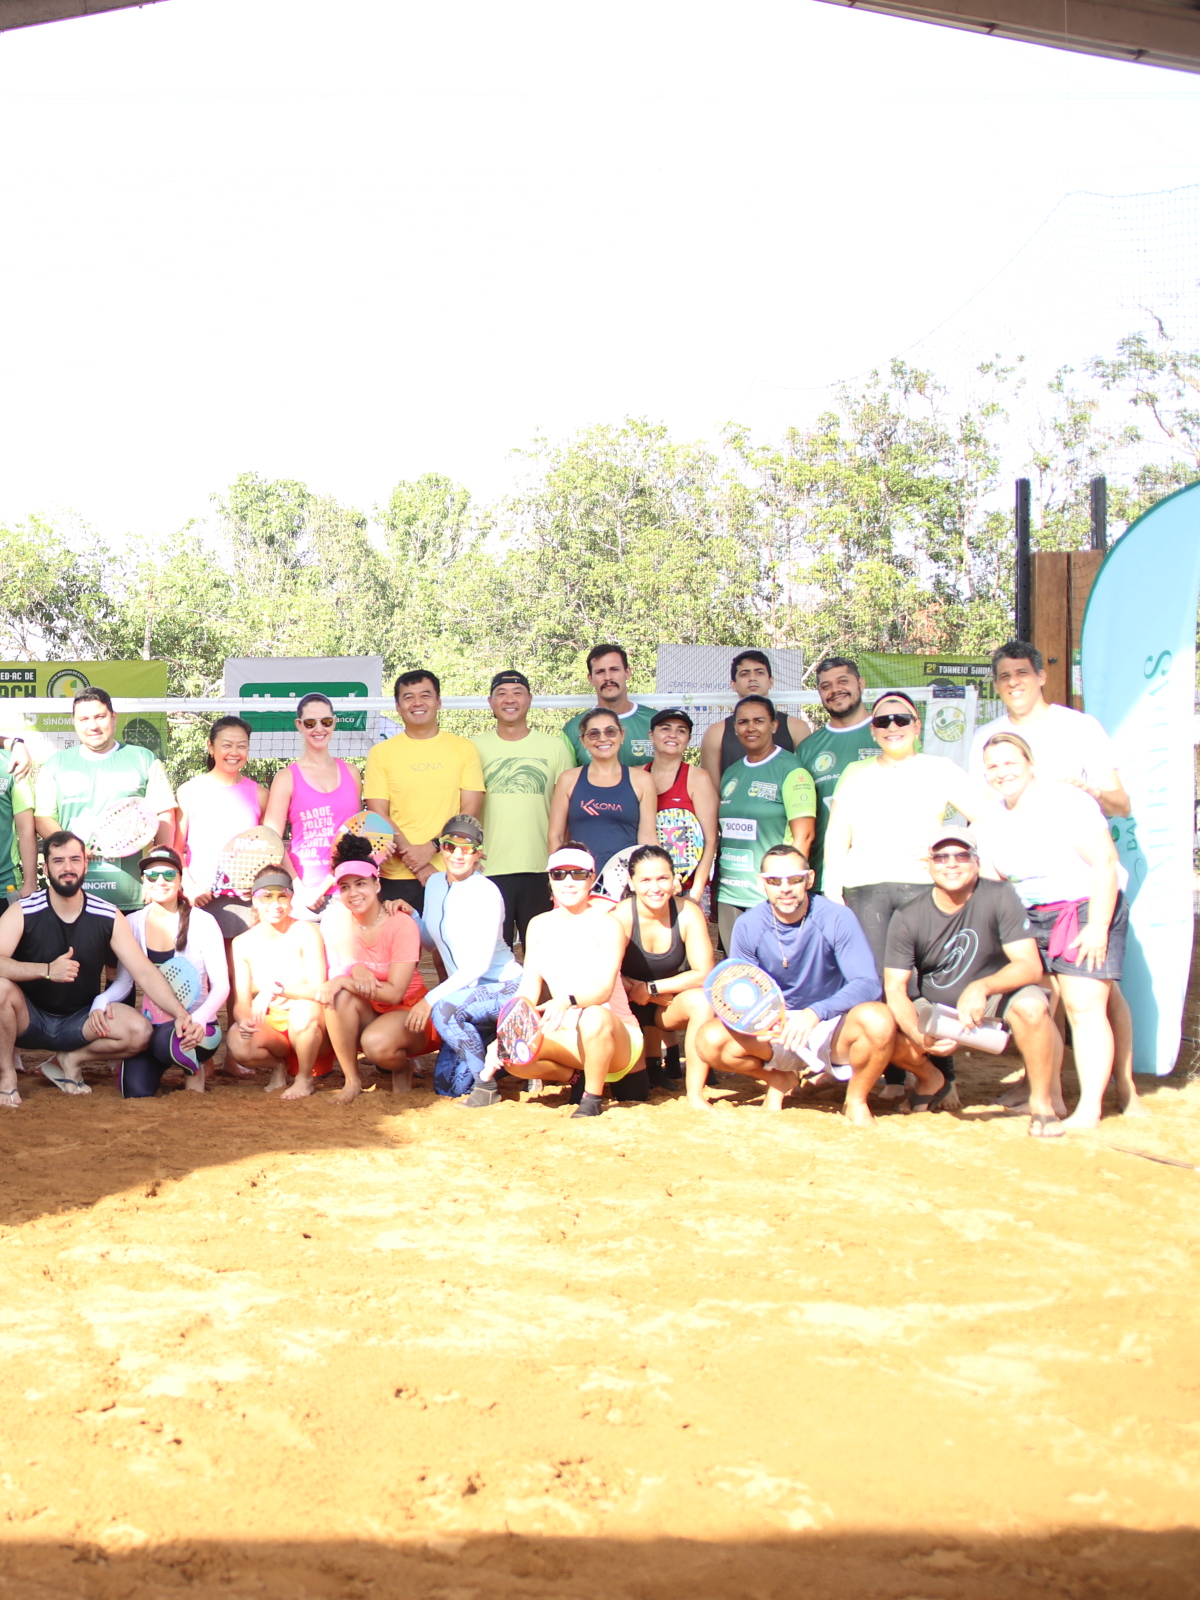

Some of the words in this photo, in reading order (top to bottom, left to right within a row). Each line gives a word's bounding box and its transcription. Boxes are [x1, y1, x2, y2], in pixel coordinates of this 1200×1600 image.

[939, 666, 968, 674] TORNEIO
[25, 671, 34, 681] DE
[409, 762, 445, 771] KONA
[726, 822, 754, 832] SICOOB
[81, 882, 117, 890] NINORTE
